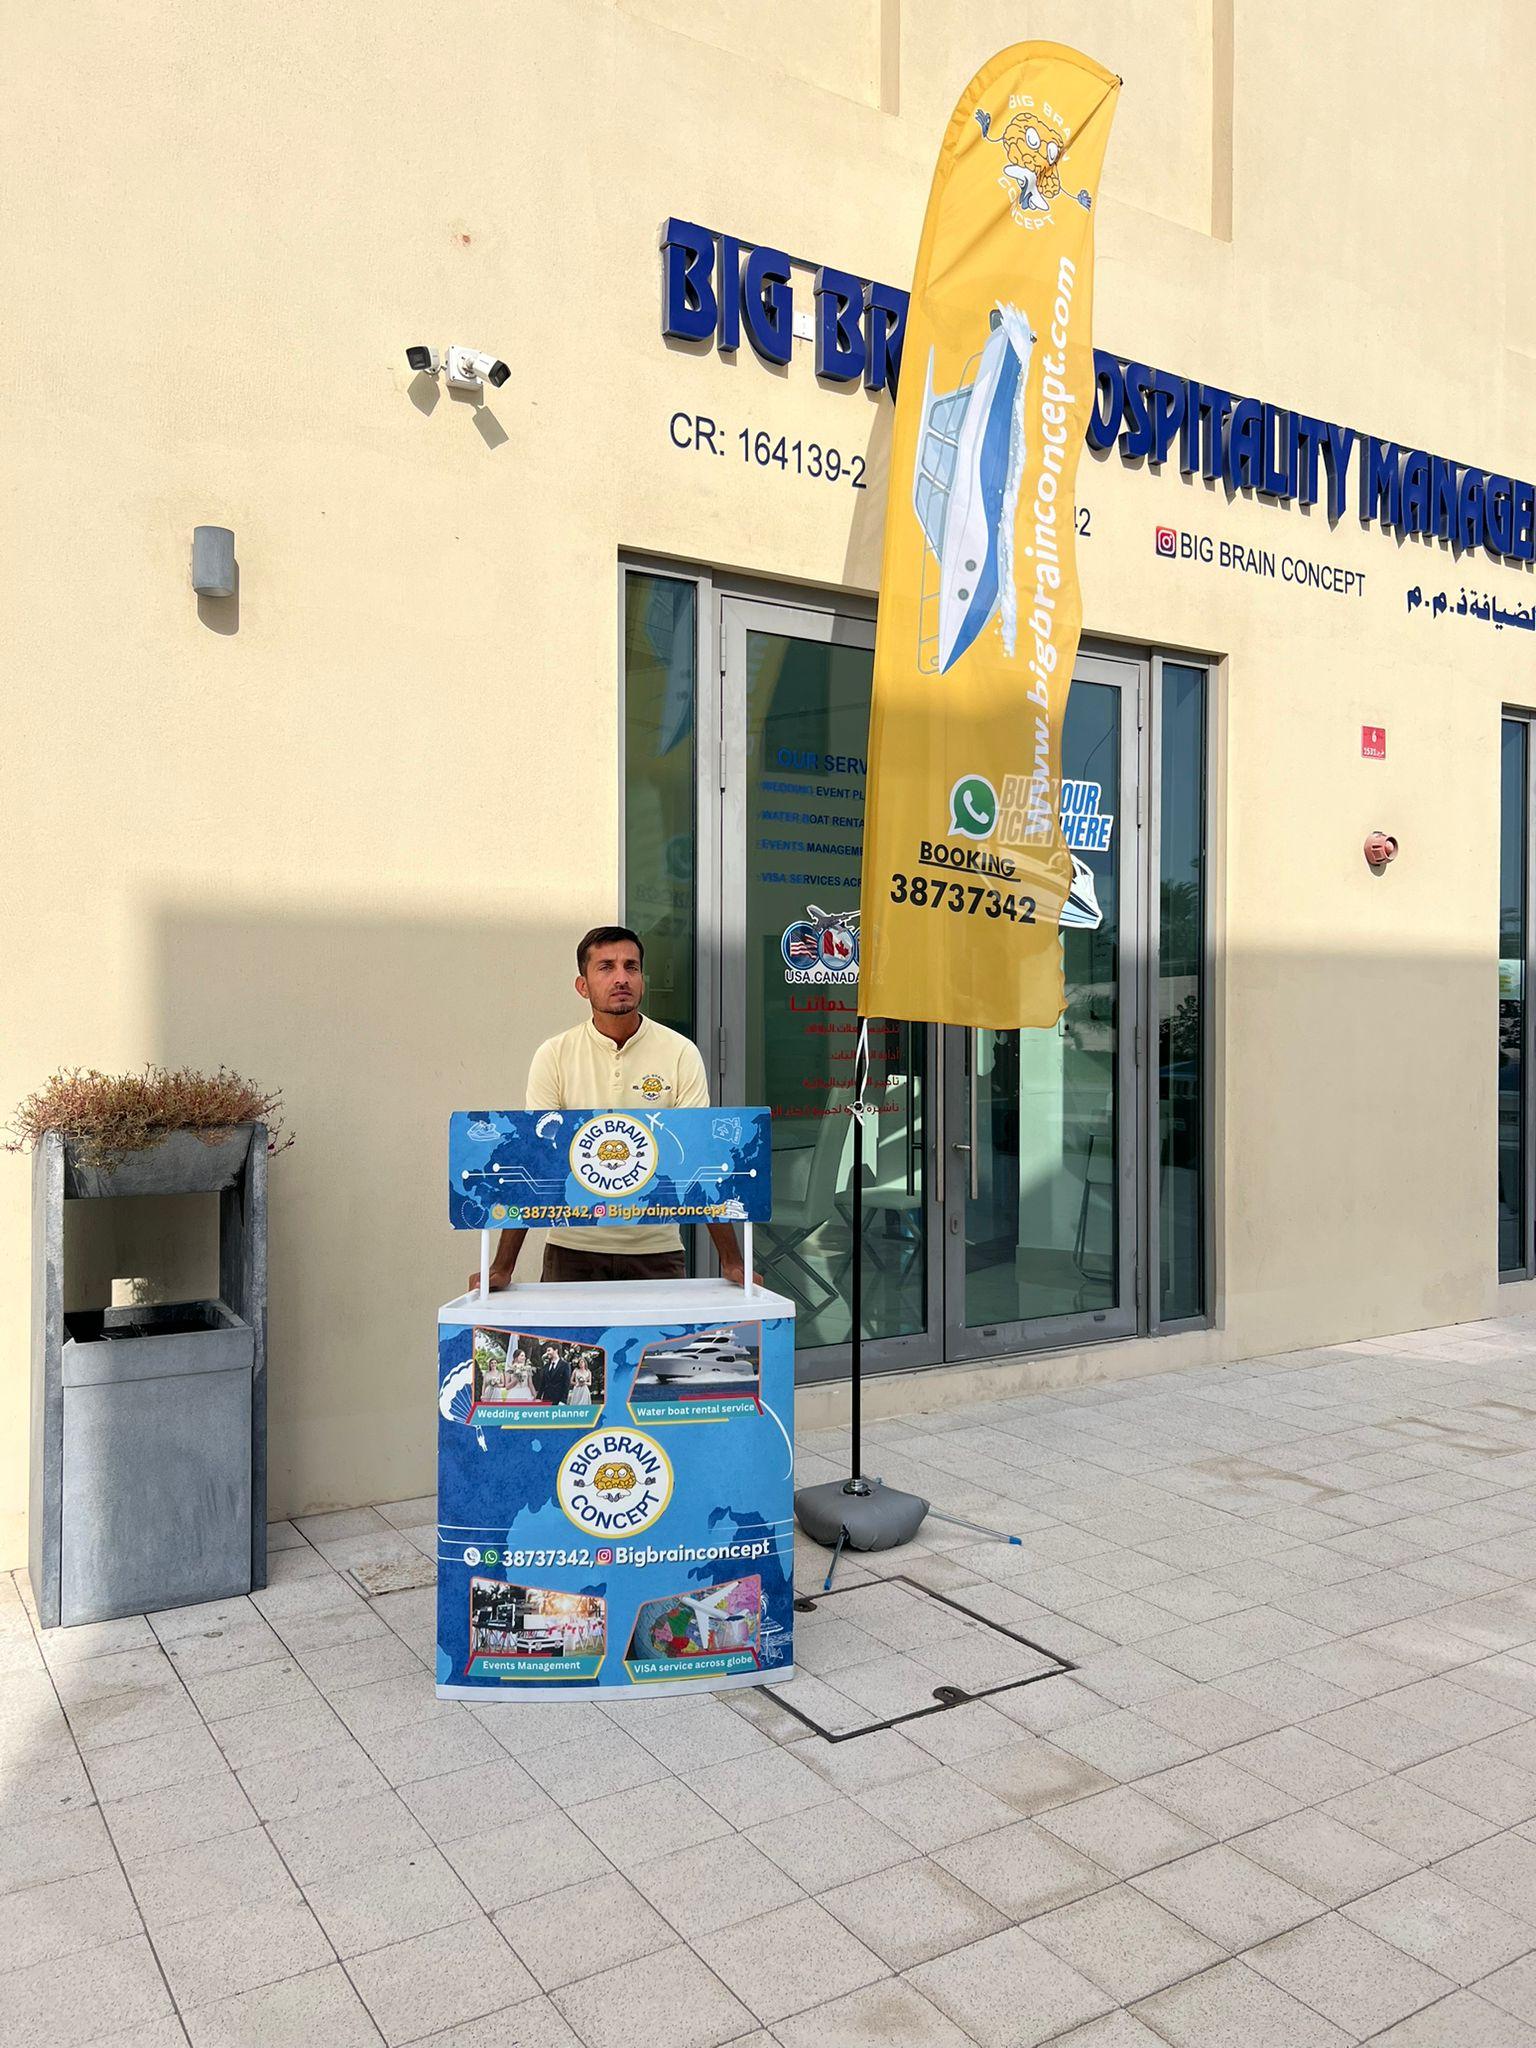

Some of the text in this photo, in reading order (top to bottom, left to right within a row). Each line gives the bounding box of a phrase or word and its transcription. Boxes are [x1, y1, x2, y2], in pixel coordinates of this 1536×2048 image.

[1008, 95, 1034, 109] BIG
[660, 216, 793, 366] BIG
[670, 412, 867, 489] CR: 164139-2
[1085, 348, 1536, 564] OSPITALITY MANAGE
[1024, 256, 1076, 837] www.bigbrainconcept.com
[1181, 532, 1366, 597] BIG BRAIN CONCEPT
[777, 747, 867, 776] OUR SERV
[816, 786, 850, 799] EVENT
[801, 813, 830, 825] BOAT
[832, 816, 865, 828] RENTA
[1062, 815, 1110, 848] HERE
[761, 839, 863, 857] EVENTS MANAGEME
[920, 840, 1016, 877] BOOKING
[762, 872, 786, 883] VISA
[789, 873, 841, 886] SERVICES
[890, 873, 1036, 924] 38737342
[579, 1120, 649, 1150] BIG BRAIN
[580, 1161, 648, 1190] CONCEPT
[608, 1202, 727, 1221] Bigbrainconcept
[477, 1408, 589, 1421] Wedding event planner
[636, 1402, 755, 1418] Water boat rental service
[569, 1436, 661, 1476] BIG BRAIN
[571, 1489, 660, 1530] CONCEPT
[615, 1539, 770, 1568] Bigbrainconcept
[482, 1660, 581, 1673] Events Management
[633, 1655, 753, 1674] VISA service across globe
